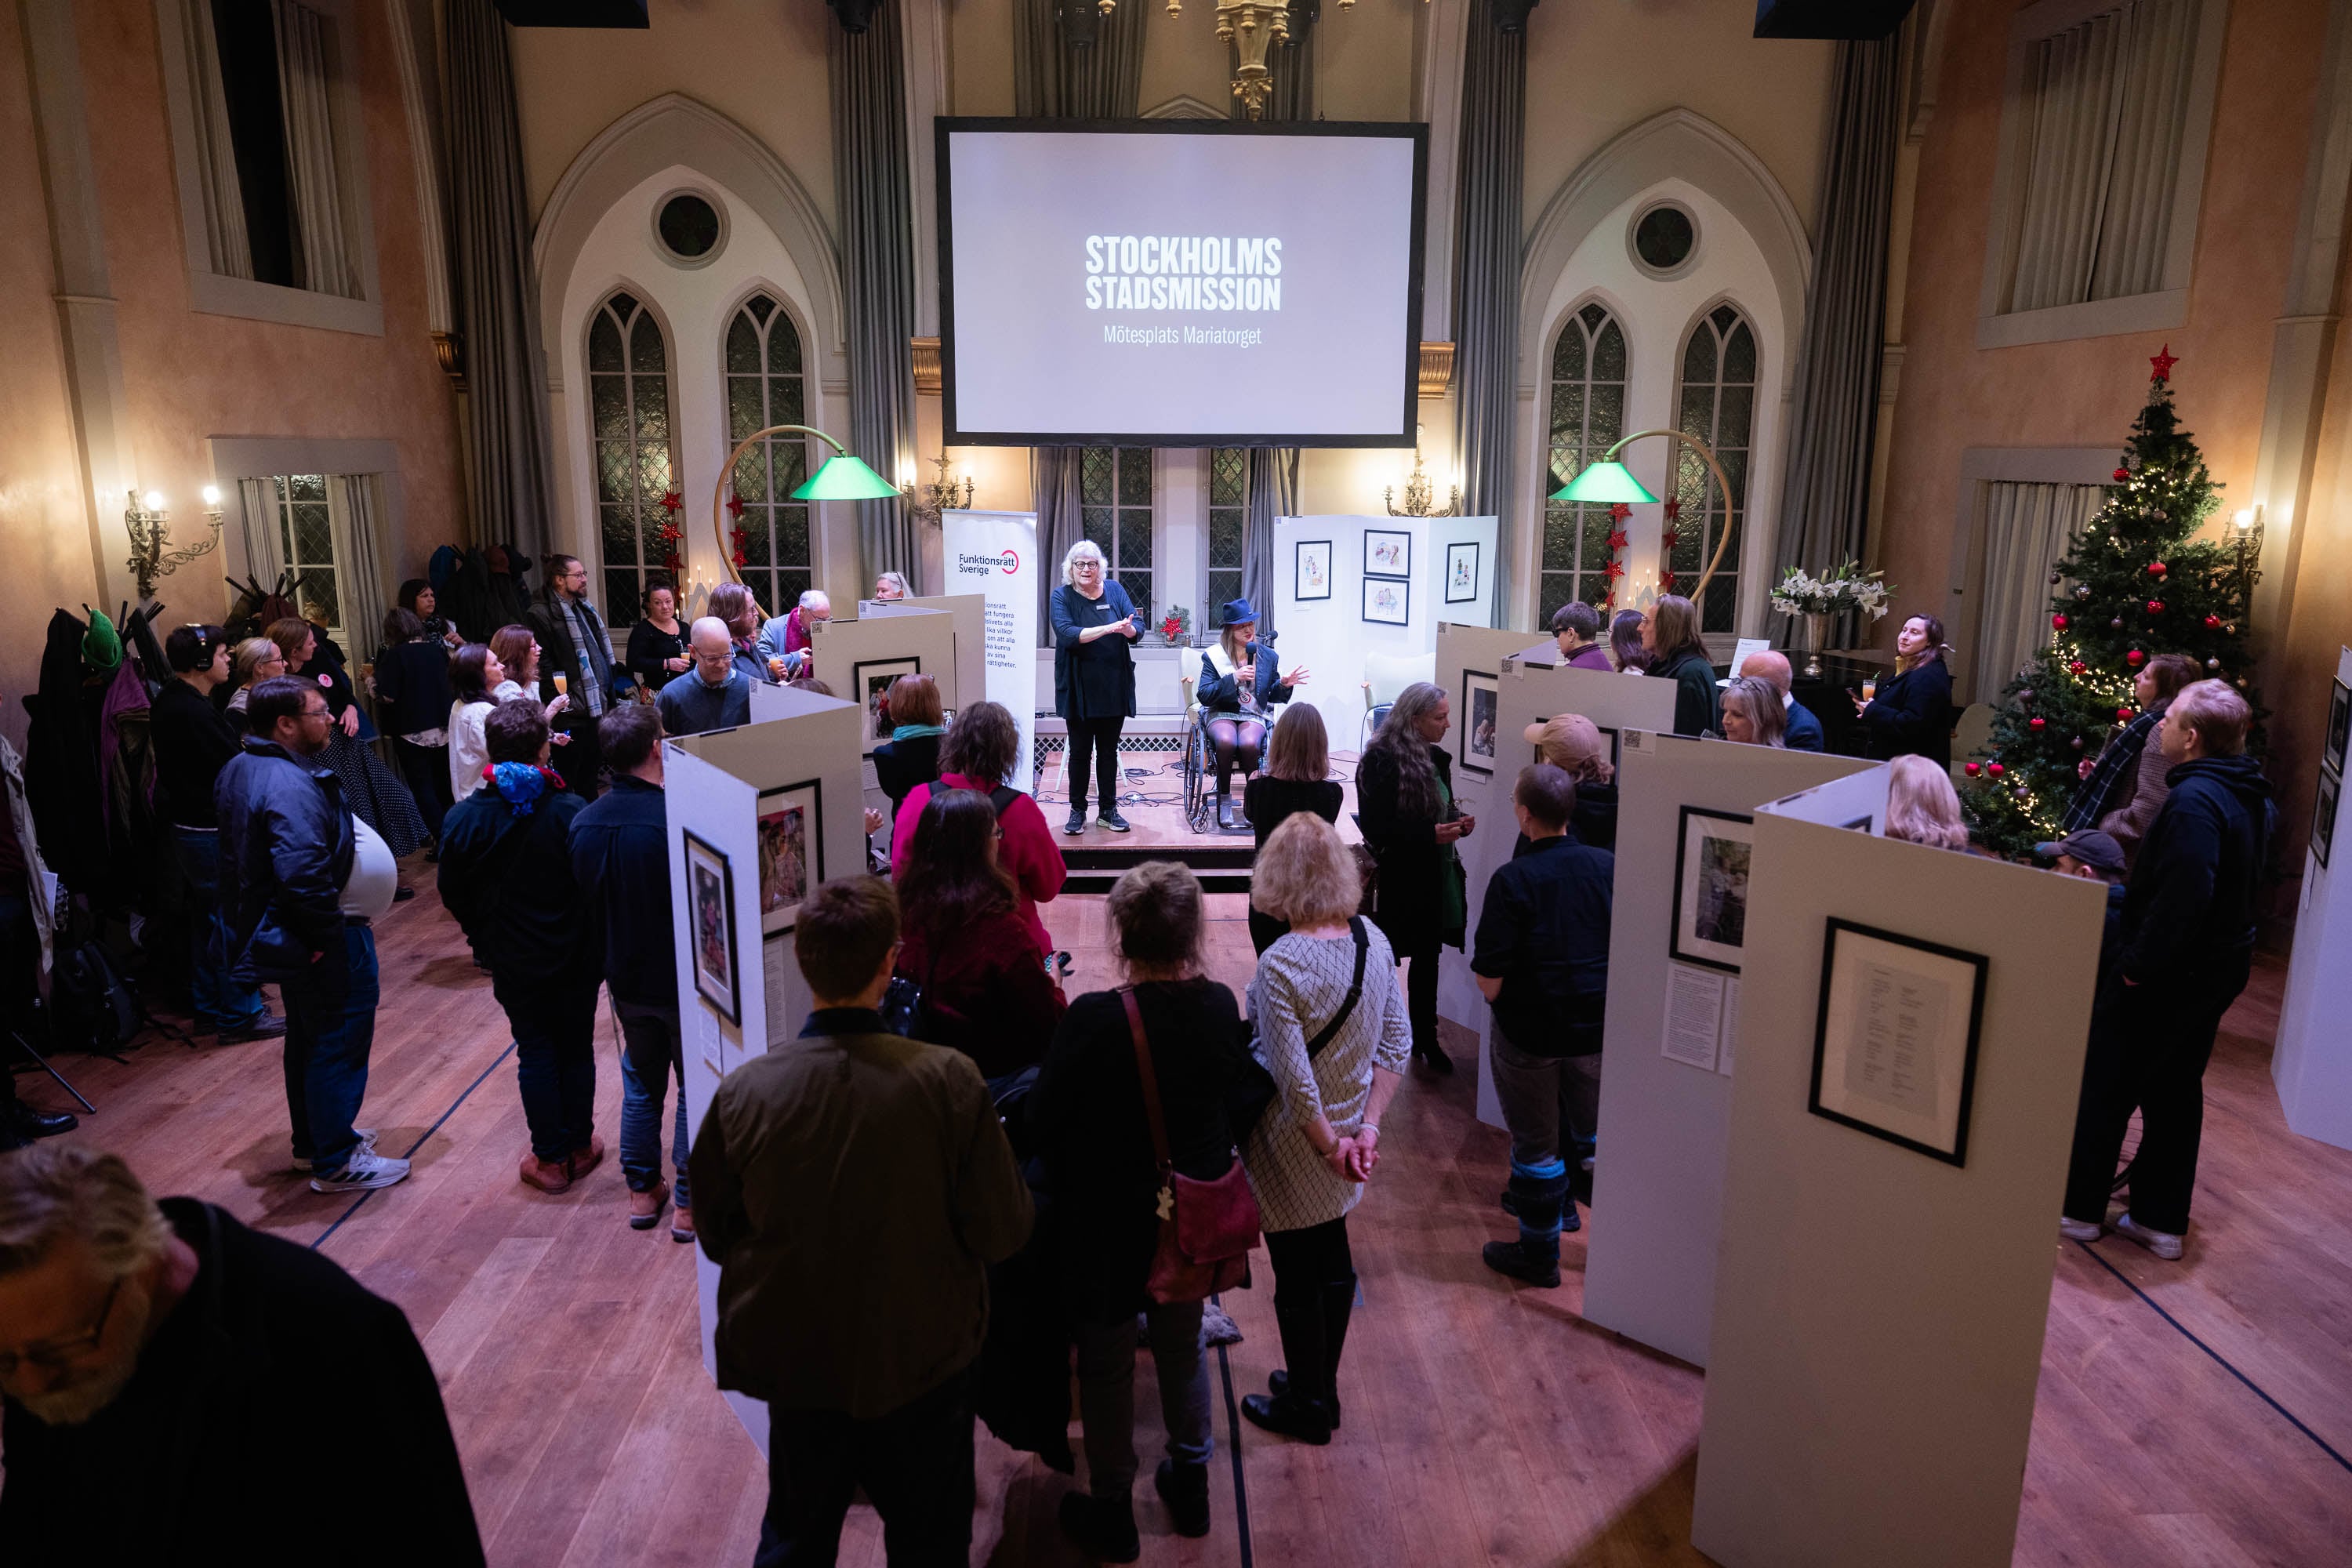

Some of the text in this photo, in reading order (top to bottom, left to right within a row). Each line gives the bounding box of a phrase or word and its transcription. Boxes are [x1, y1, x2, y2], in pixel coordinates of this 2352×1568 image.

[1086, 235, 1282, 275] STOCKHOLMS
[1086, 275, 1281, 310] STADSMISSION
[1104, 325, 1261, 348] Mötesplats Mariatorget
[959, 554, 1014, 567] Funktionsrätt
[959, 564, 989, 576] Sverige
